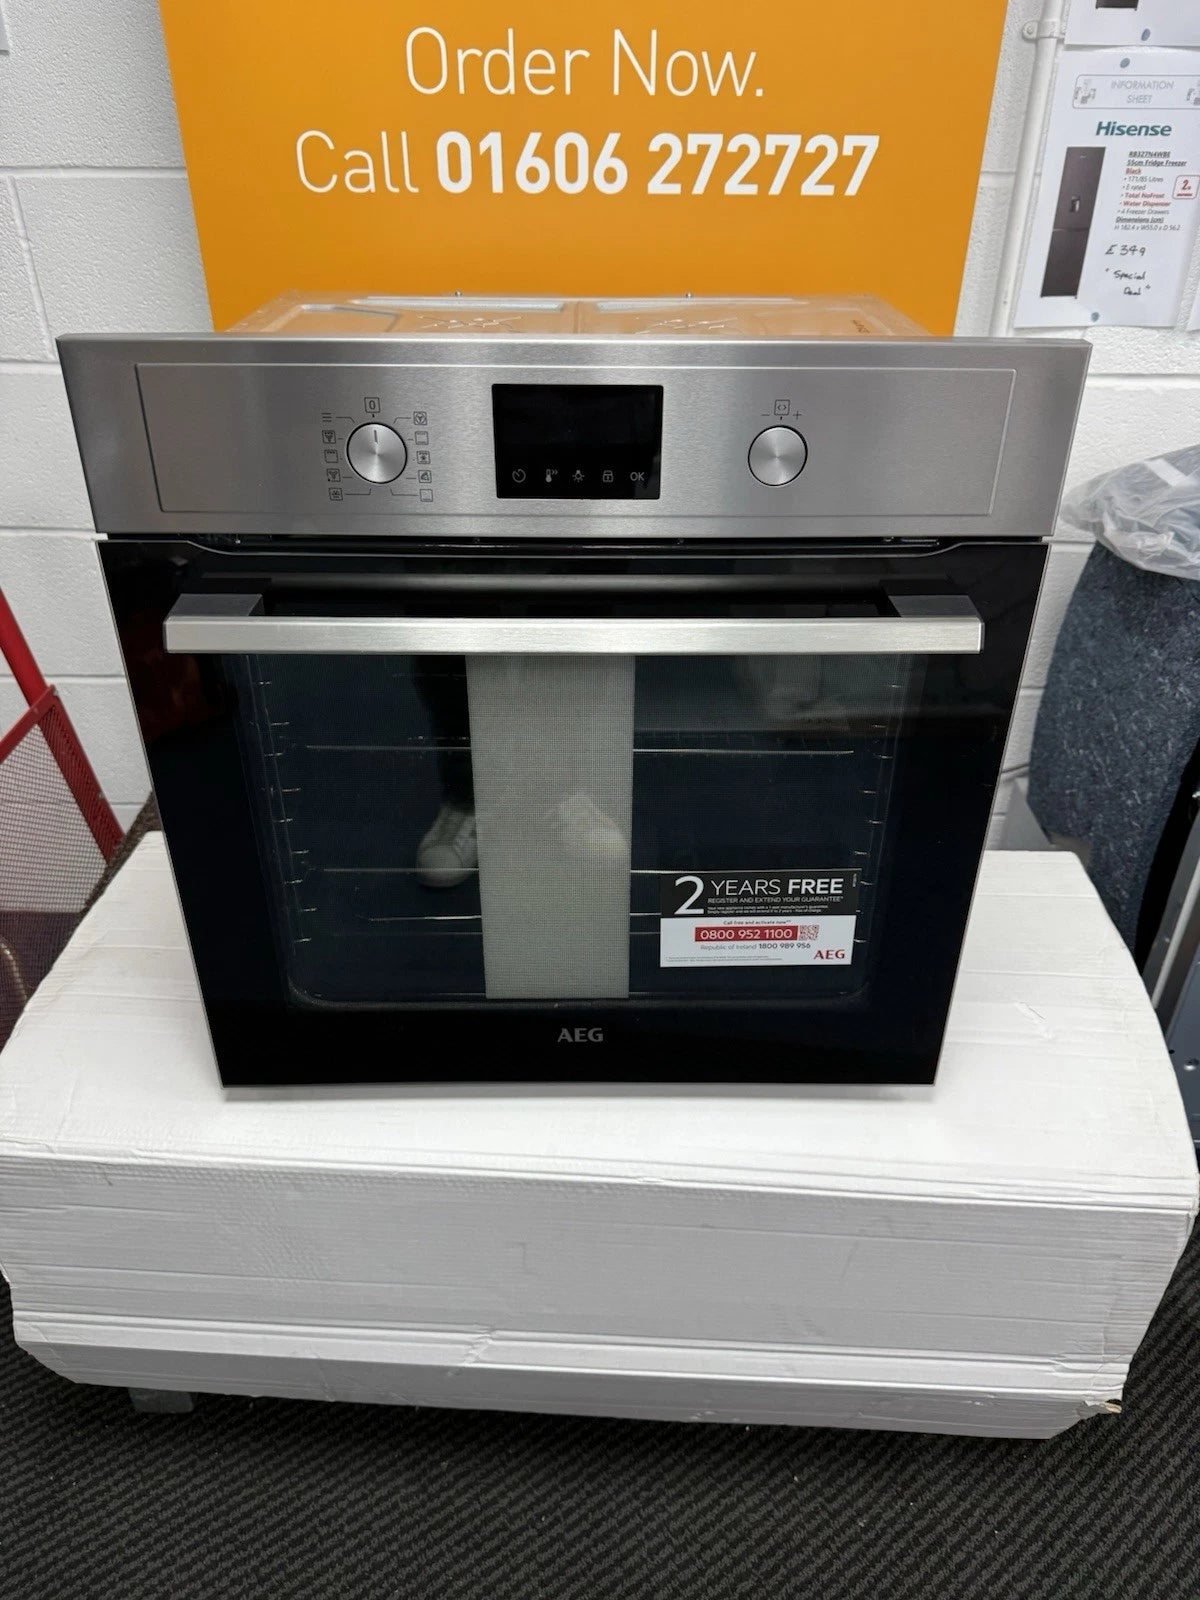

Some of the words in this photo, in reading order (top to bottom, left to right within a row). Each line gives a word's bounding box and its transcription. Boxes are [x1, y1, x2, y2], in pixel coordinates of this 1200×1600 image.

[405, 26, 590, 96] Order
[612, 29, 765, 97] Now.
[1111, 80, 1175, 90] INFORMATION
[1126, 94, 1152, 104] SHEET
[1095, 121, 1172, 136] Hisense
[295, 130, 419, 194] Call
[436, 131, 628, 195] 01606
[647, 133, 880, 196] 272727
[630, 471, 645, 482] OK
[711, 879, 781, 896] YEARS
[788, 878, 844, 894] FREE
[674, 876, 705, 915] 2
[700, 930, 734, 940] 0800
[738, 929, 761, 939] 952
[765, 928, 793, 938] 1100
[813, 949, 845, 960] AEG
[557, 1027, 604, 1043] AEG
